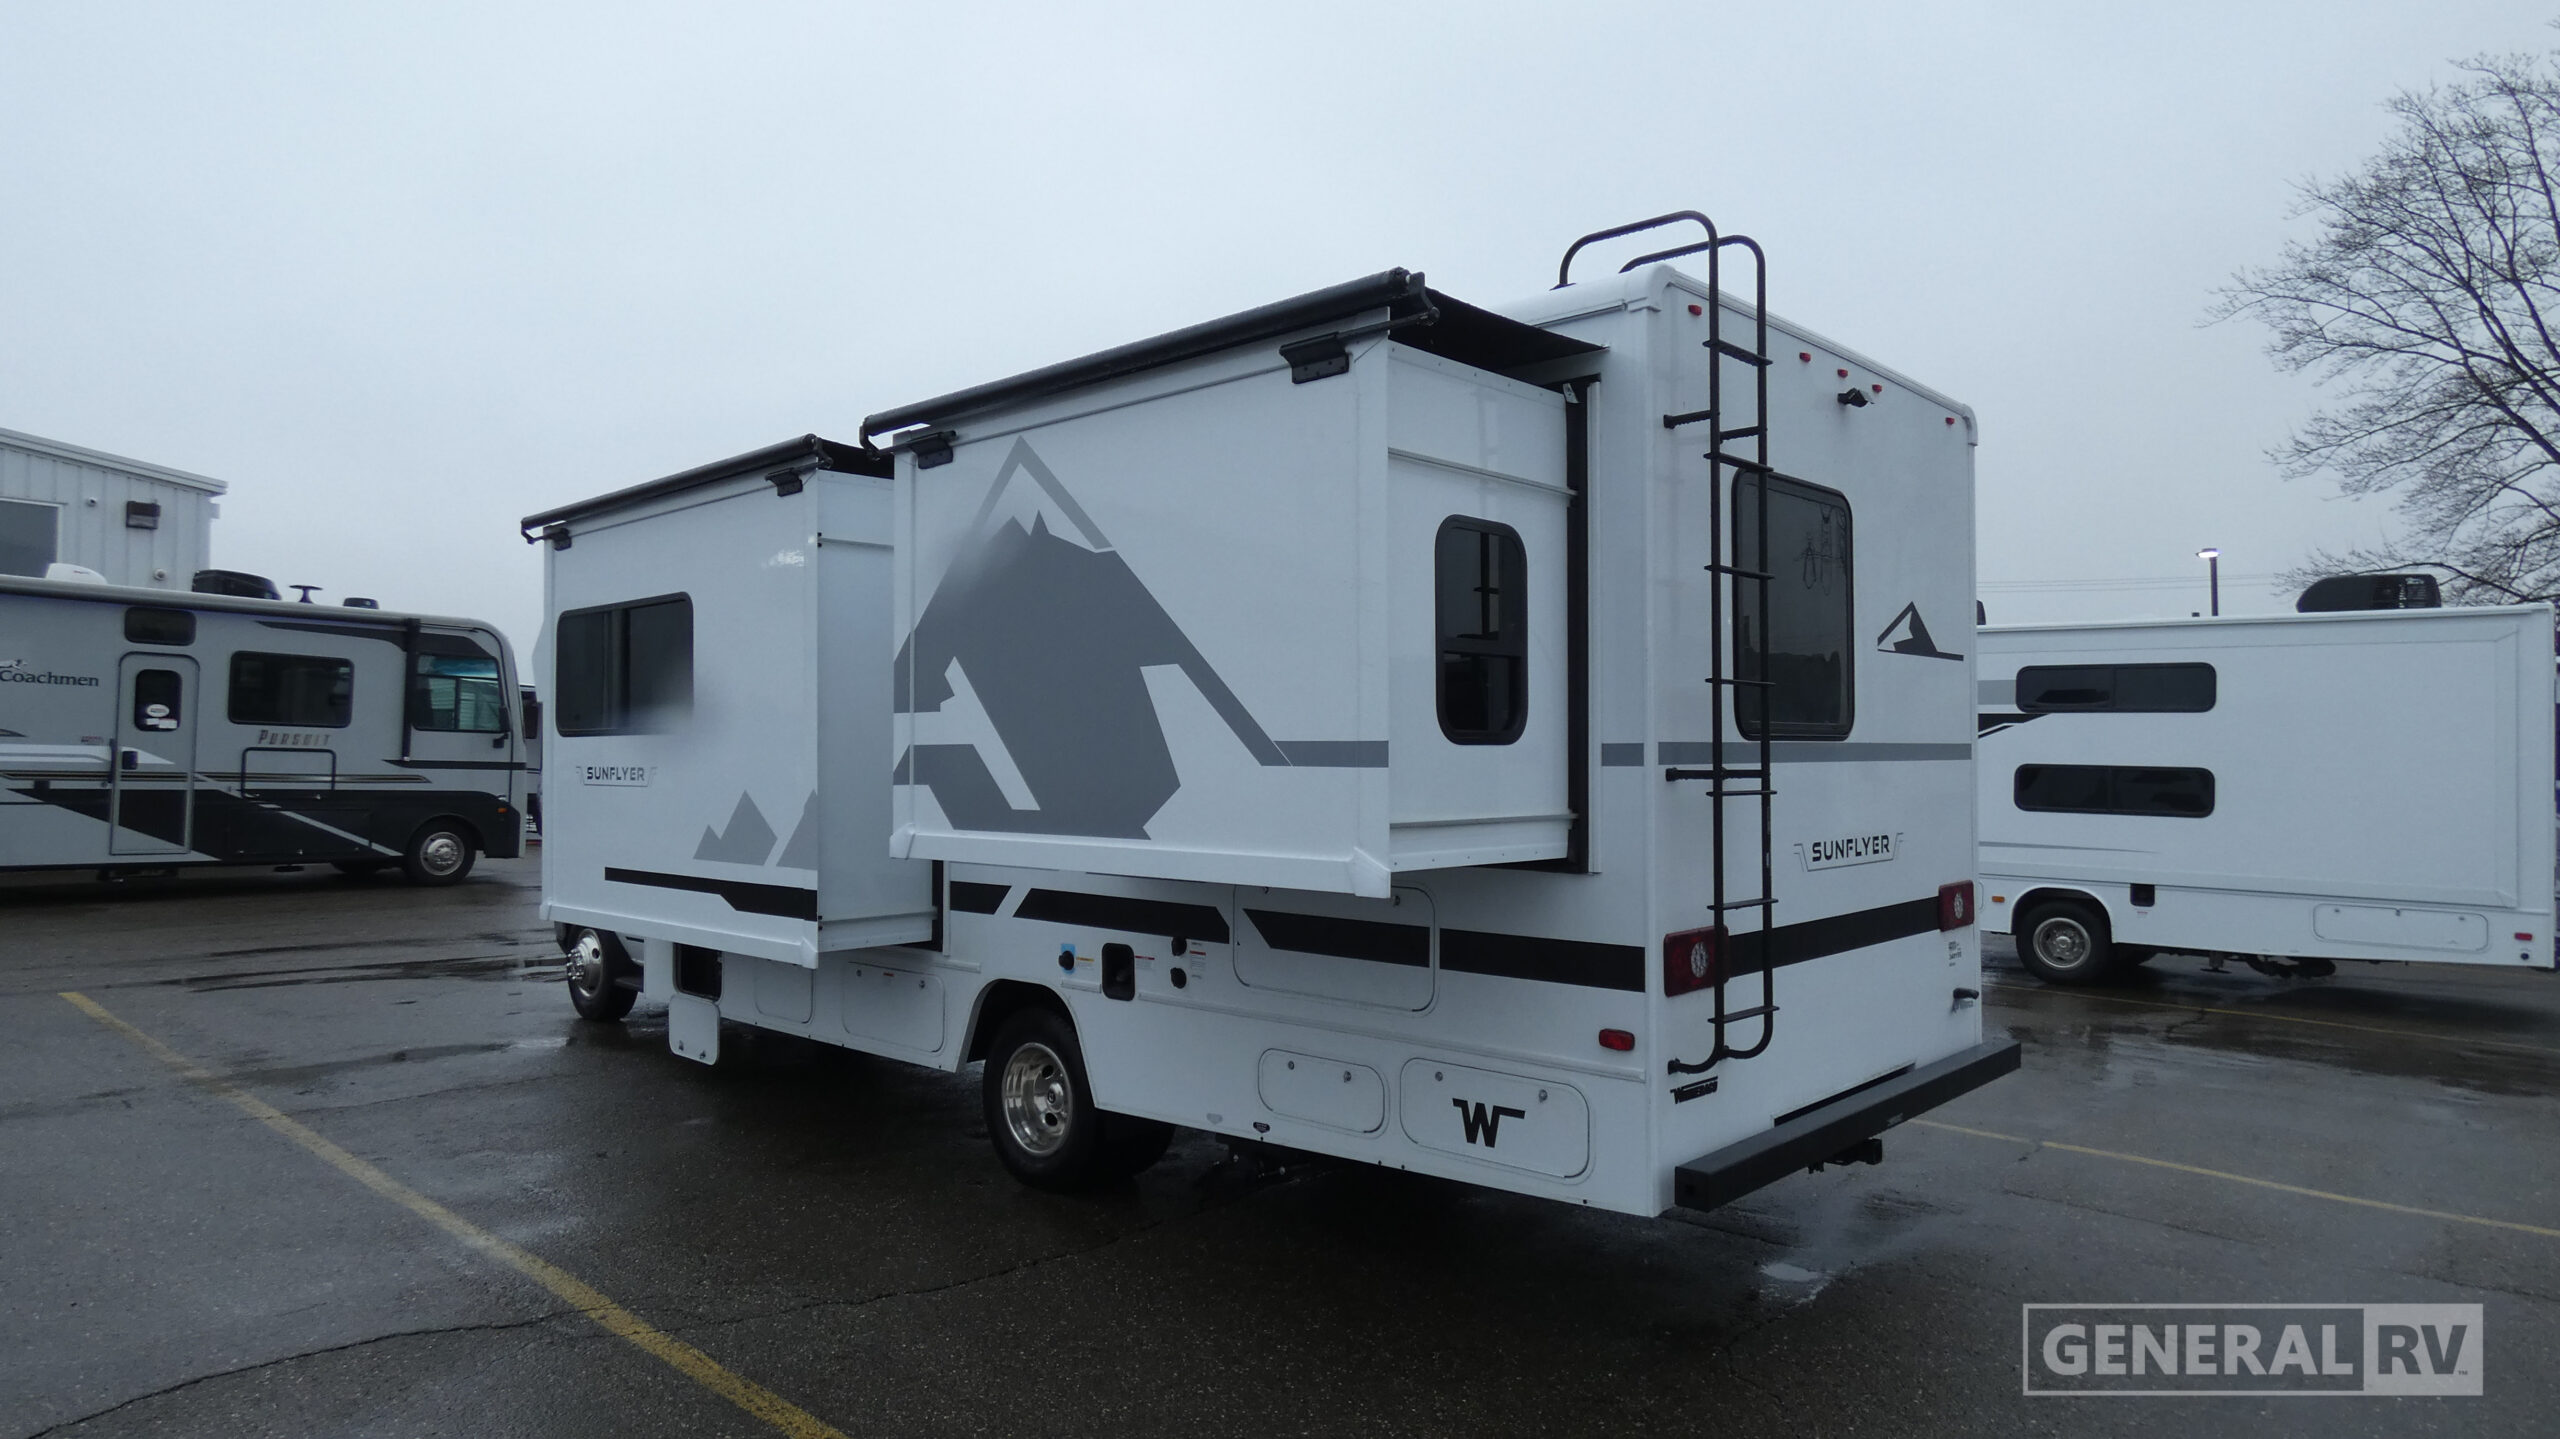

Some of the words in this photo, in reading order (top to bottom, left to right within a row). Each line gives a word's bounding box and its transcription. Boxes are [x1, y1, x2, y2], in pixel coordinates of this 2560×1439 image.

[0, 670, 99, 687] Coachmen
[258, 729, 331, 746] PURSUIT
[587, 766, 645, 781] SUNFLYER
[1812, 835, 1890, 862] SUNFLYER
